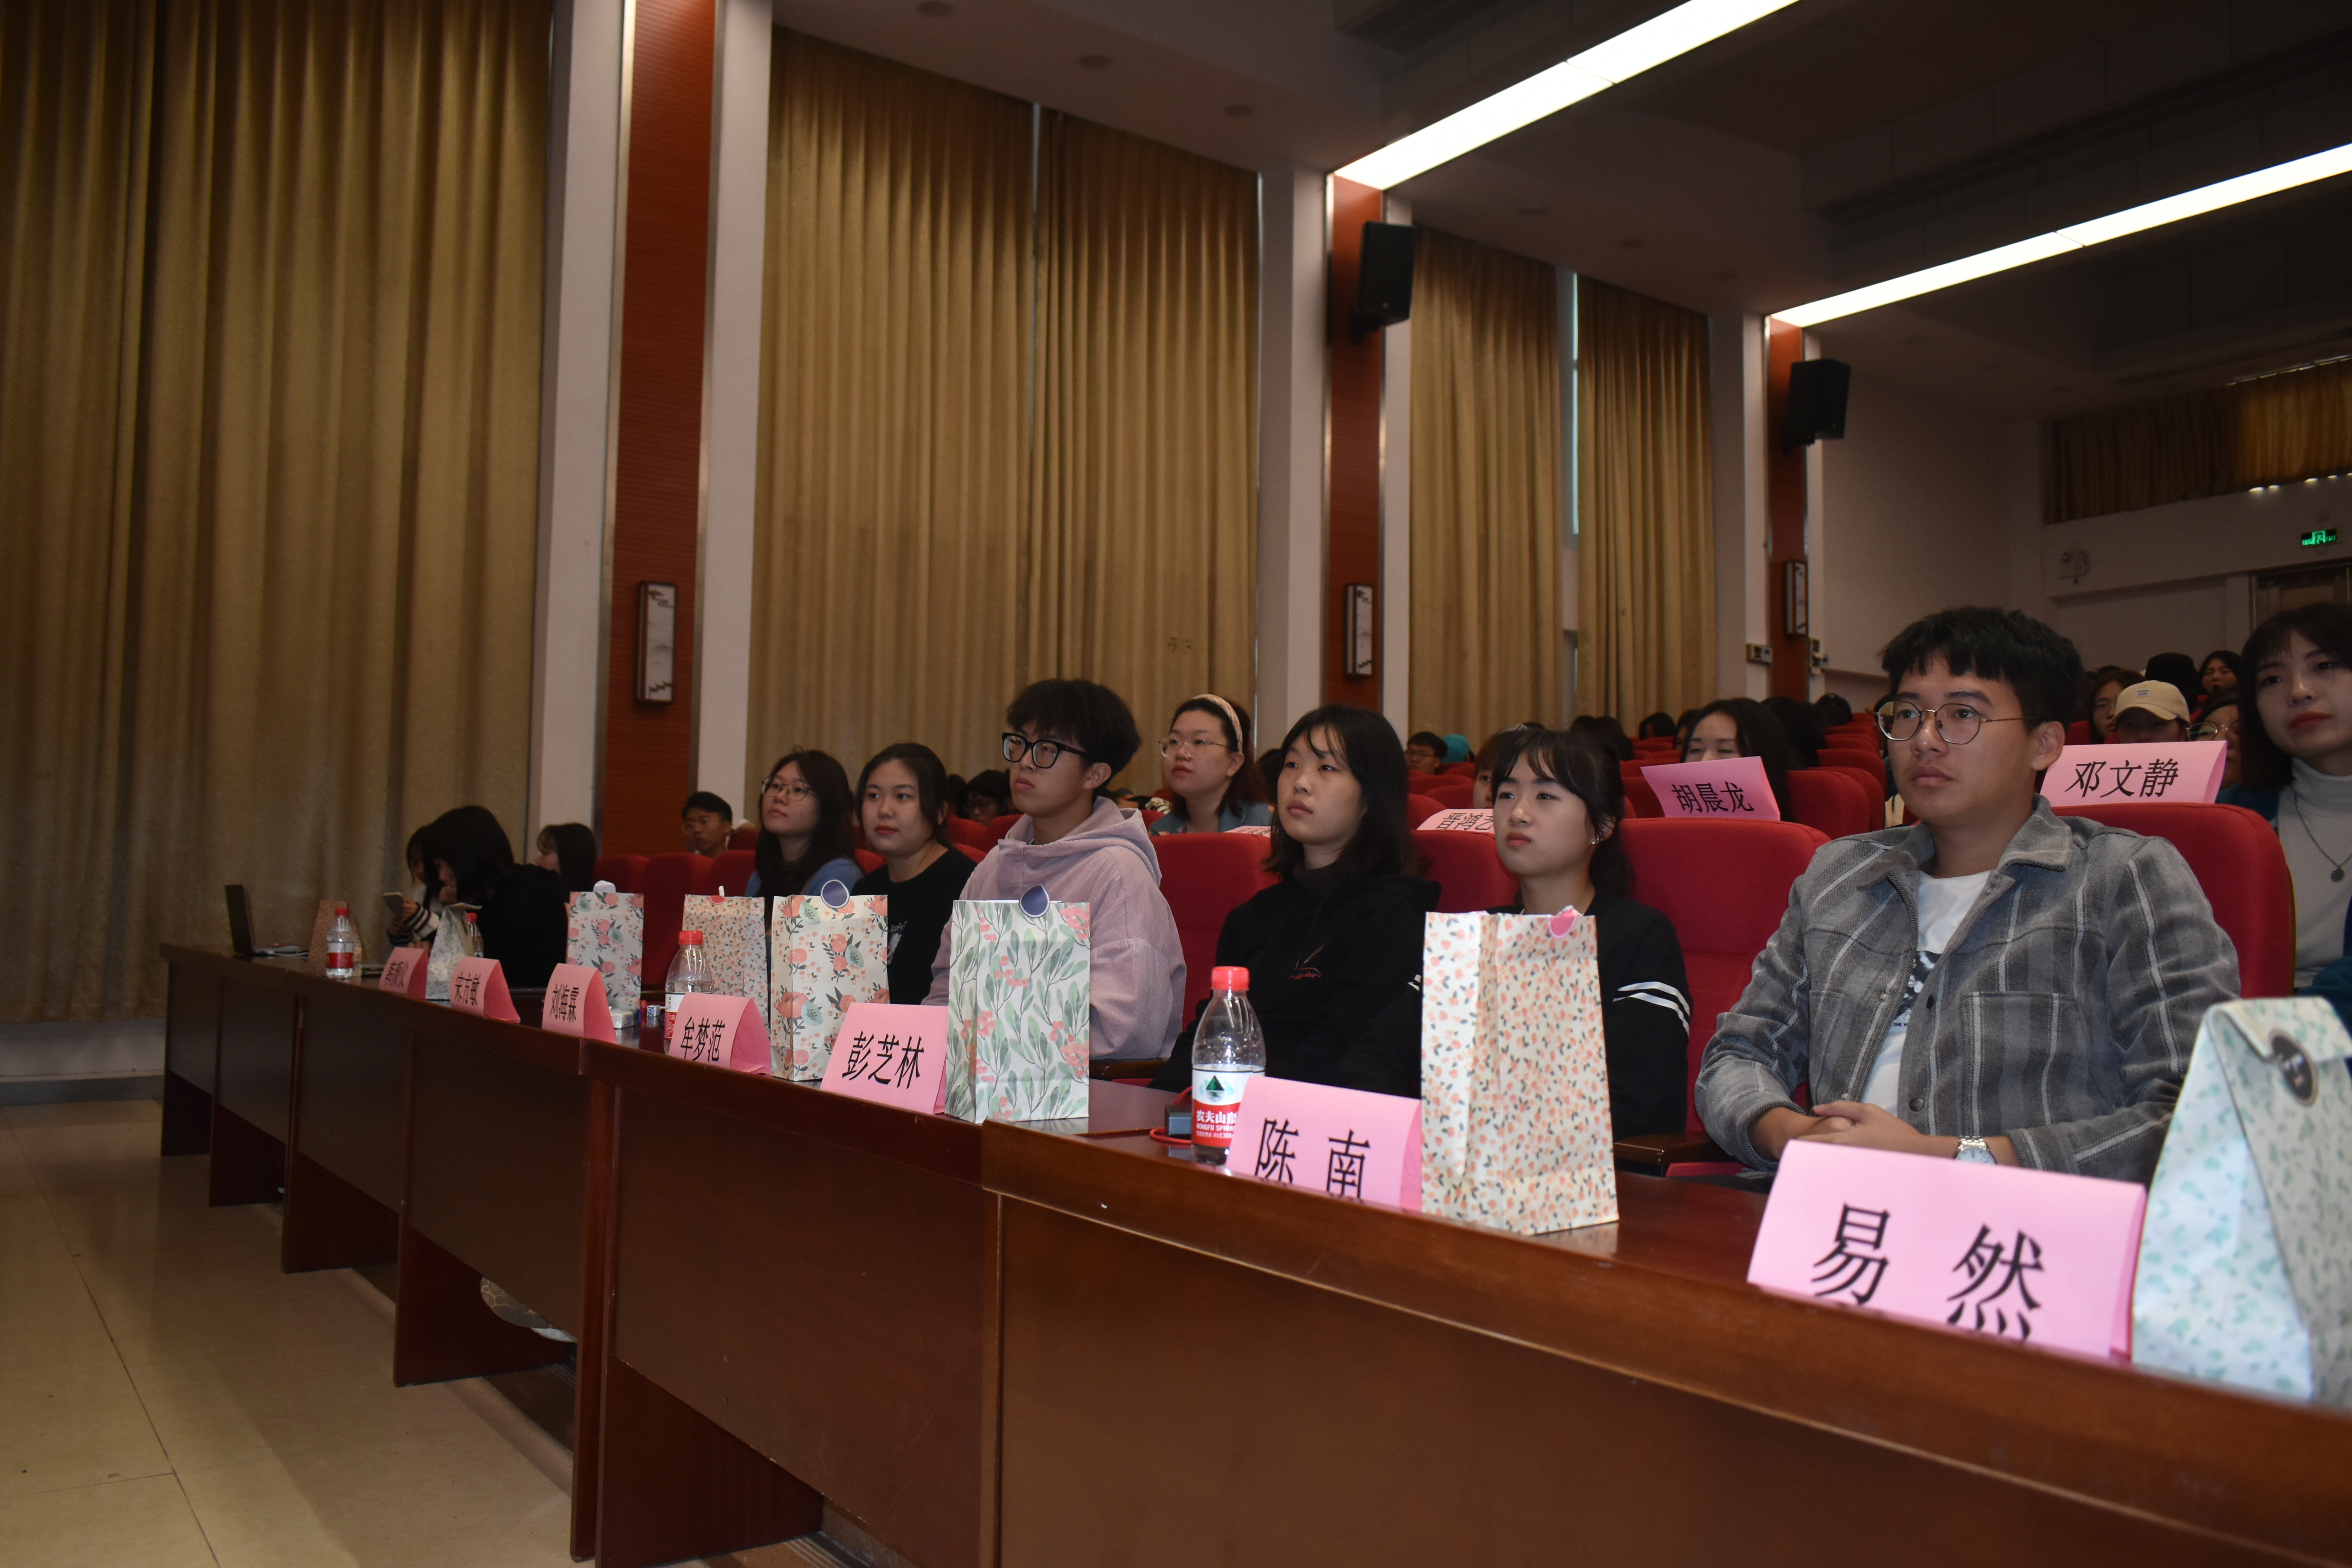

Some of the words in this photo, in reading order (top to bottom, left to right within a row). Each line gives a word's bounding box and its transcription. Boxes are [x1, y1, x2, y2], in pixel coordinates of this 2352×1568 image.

[1671, 781, 1754, 813] 胡晨龙
[2064, 758, 2179, 798] 邓文静
[550, 982, 579, 1023] 刘海霖
[681, 1015, 725, 1062] 牟梦范
[842, 1030, 924, 1089] 彭芝林
[1196, 1110, 1237, 1125] 农夫山泉
